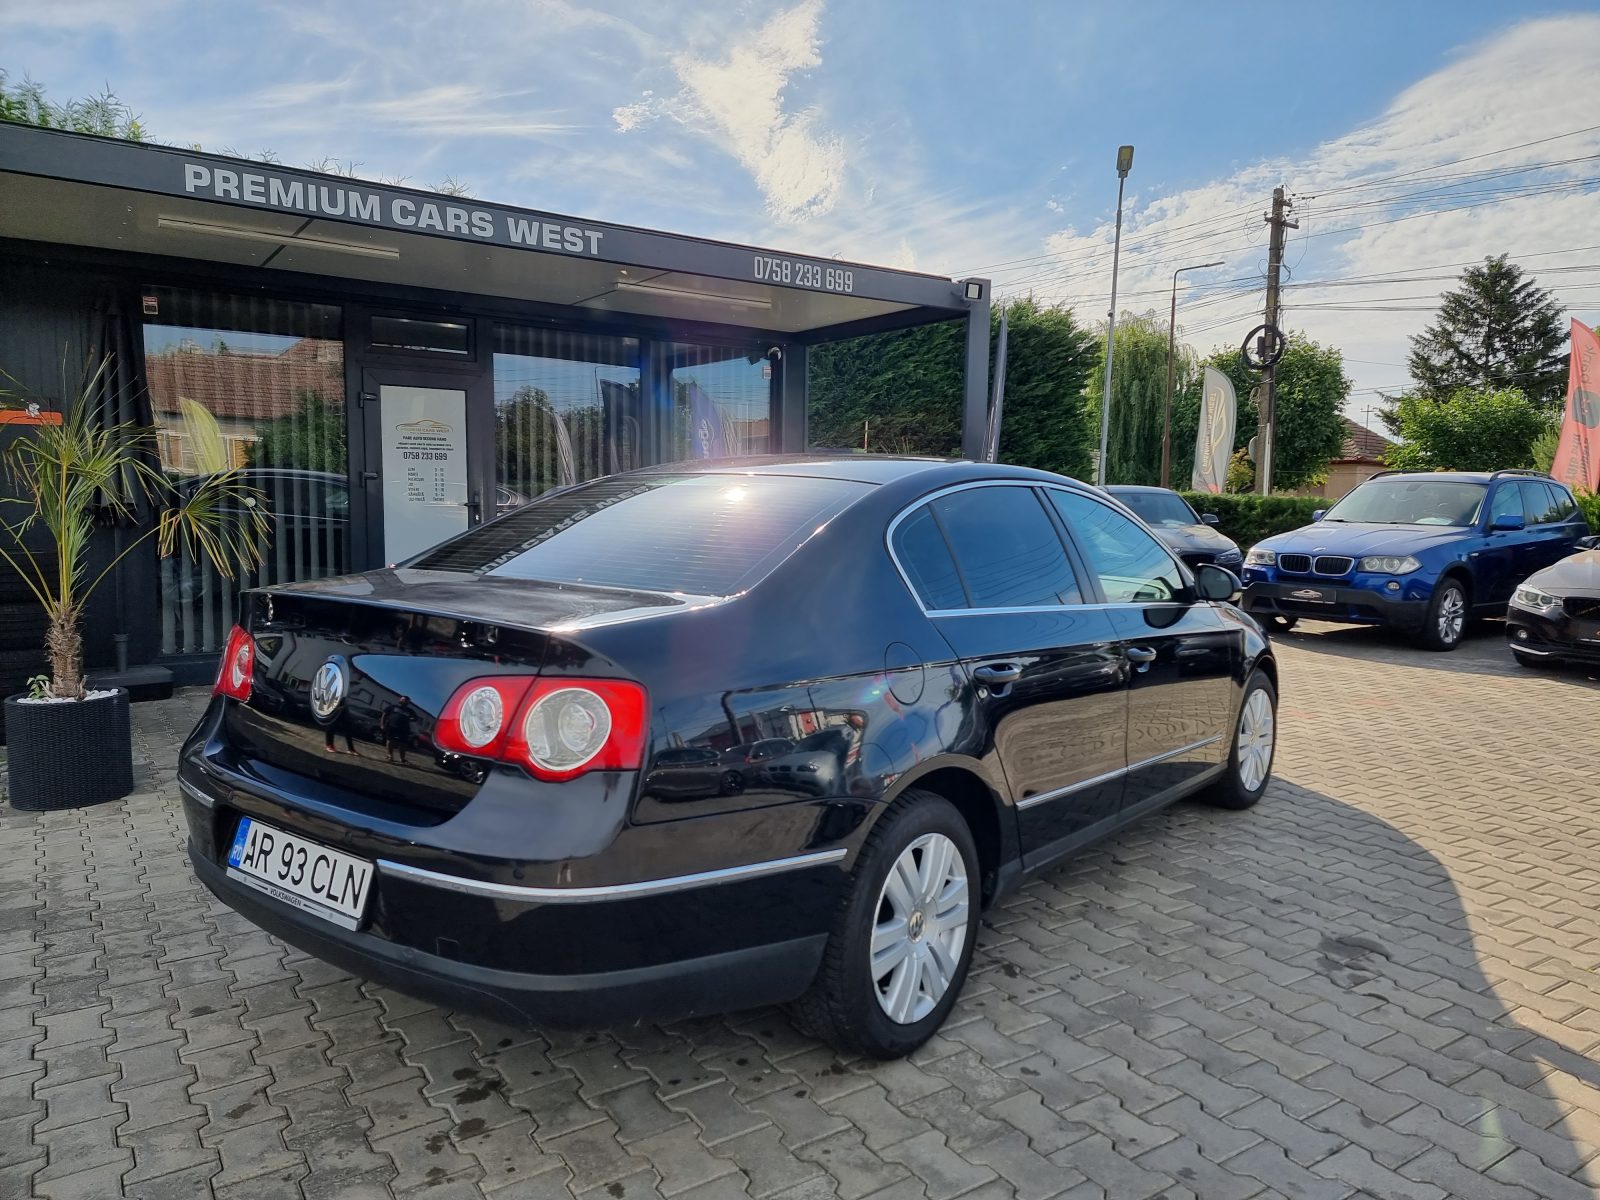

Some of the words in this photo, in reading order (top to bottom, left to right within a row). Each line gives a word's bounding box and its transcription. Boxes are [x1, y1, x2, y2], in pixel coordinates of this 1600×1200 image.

[184, 163, 381, 222] PREMIUM
[391, 199, 494, 238] CARS
[507, 217, 604, 255] WEST
[754, 256, 791, 283] 0758
[795, 263, 822, 288] 233
[826, 268, 853, 293] 699
[403, 451, 420, 460] 0758
[421, 452, 433, 460] 233
[434, 452, 448, 461] 699
[243, 829, 275, 874] AR
[277, 841, 308, 886] 93
[310, 854, 366, 910] CLN
[269, 887, 302, 907] VOLKSWAGEN
